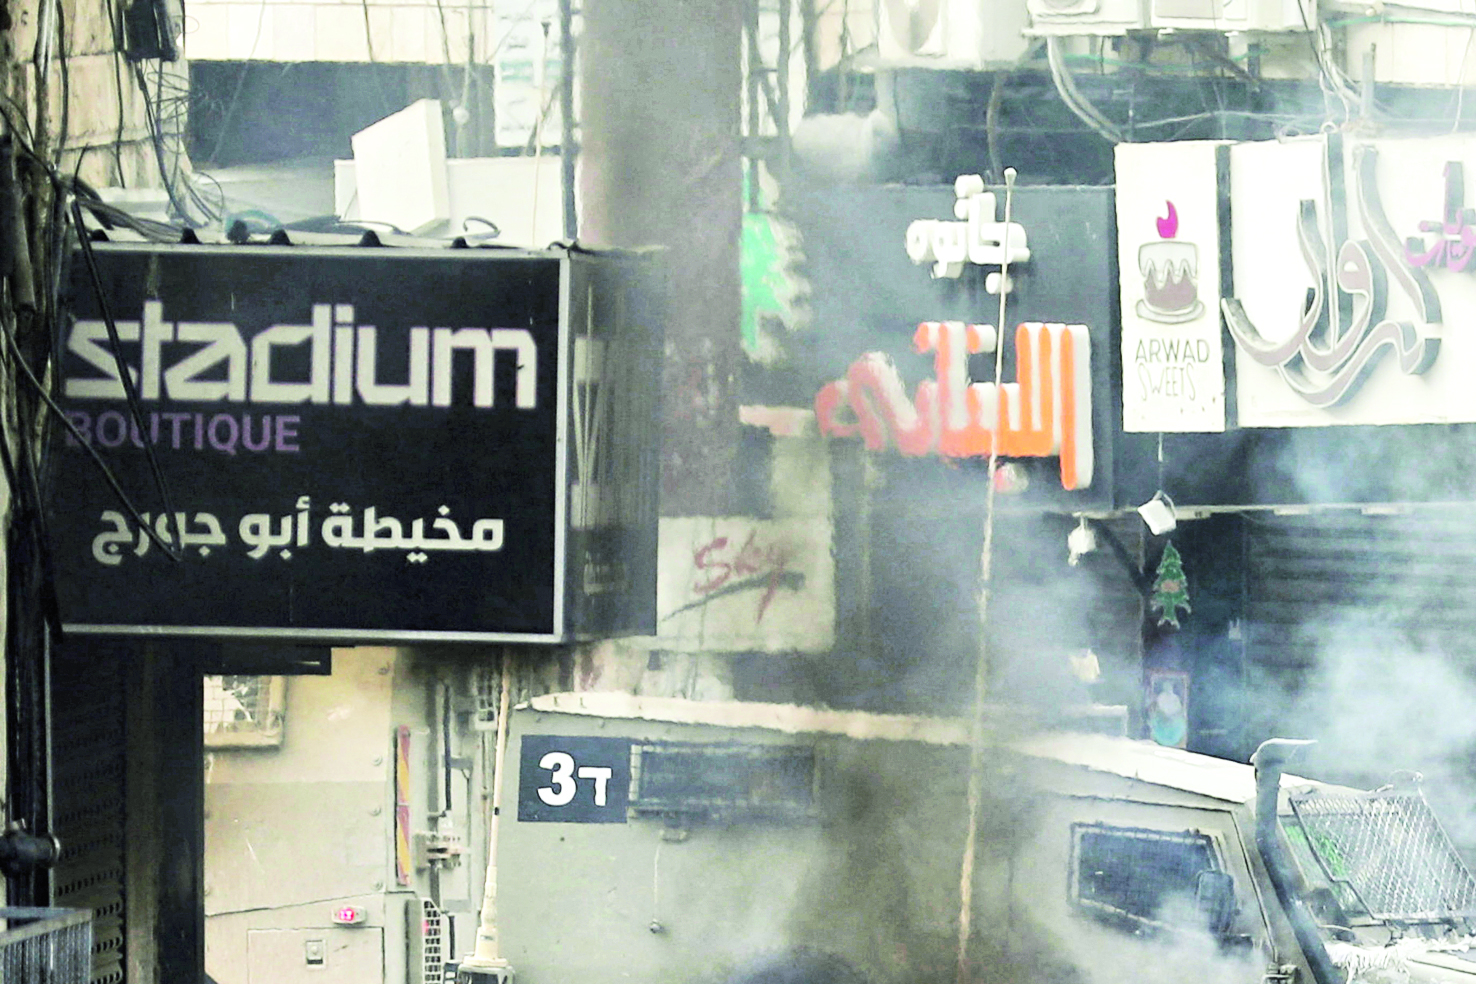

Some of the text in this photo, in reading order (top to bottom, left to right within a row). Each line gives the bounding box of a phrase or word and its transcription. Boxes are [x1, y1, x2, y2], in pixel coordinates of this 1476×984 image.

[65, 300, 537, 410] stadium
[1135, 339, 1210, 363] ARWAD
[1138, 362, 1196, 401] SWEETS
[65, 410, 301, 456] BOUTIQUE
[91, 496, 504, 565] مخيطة أبو جورج
